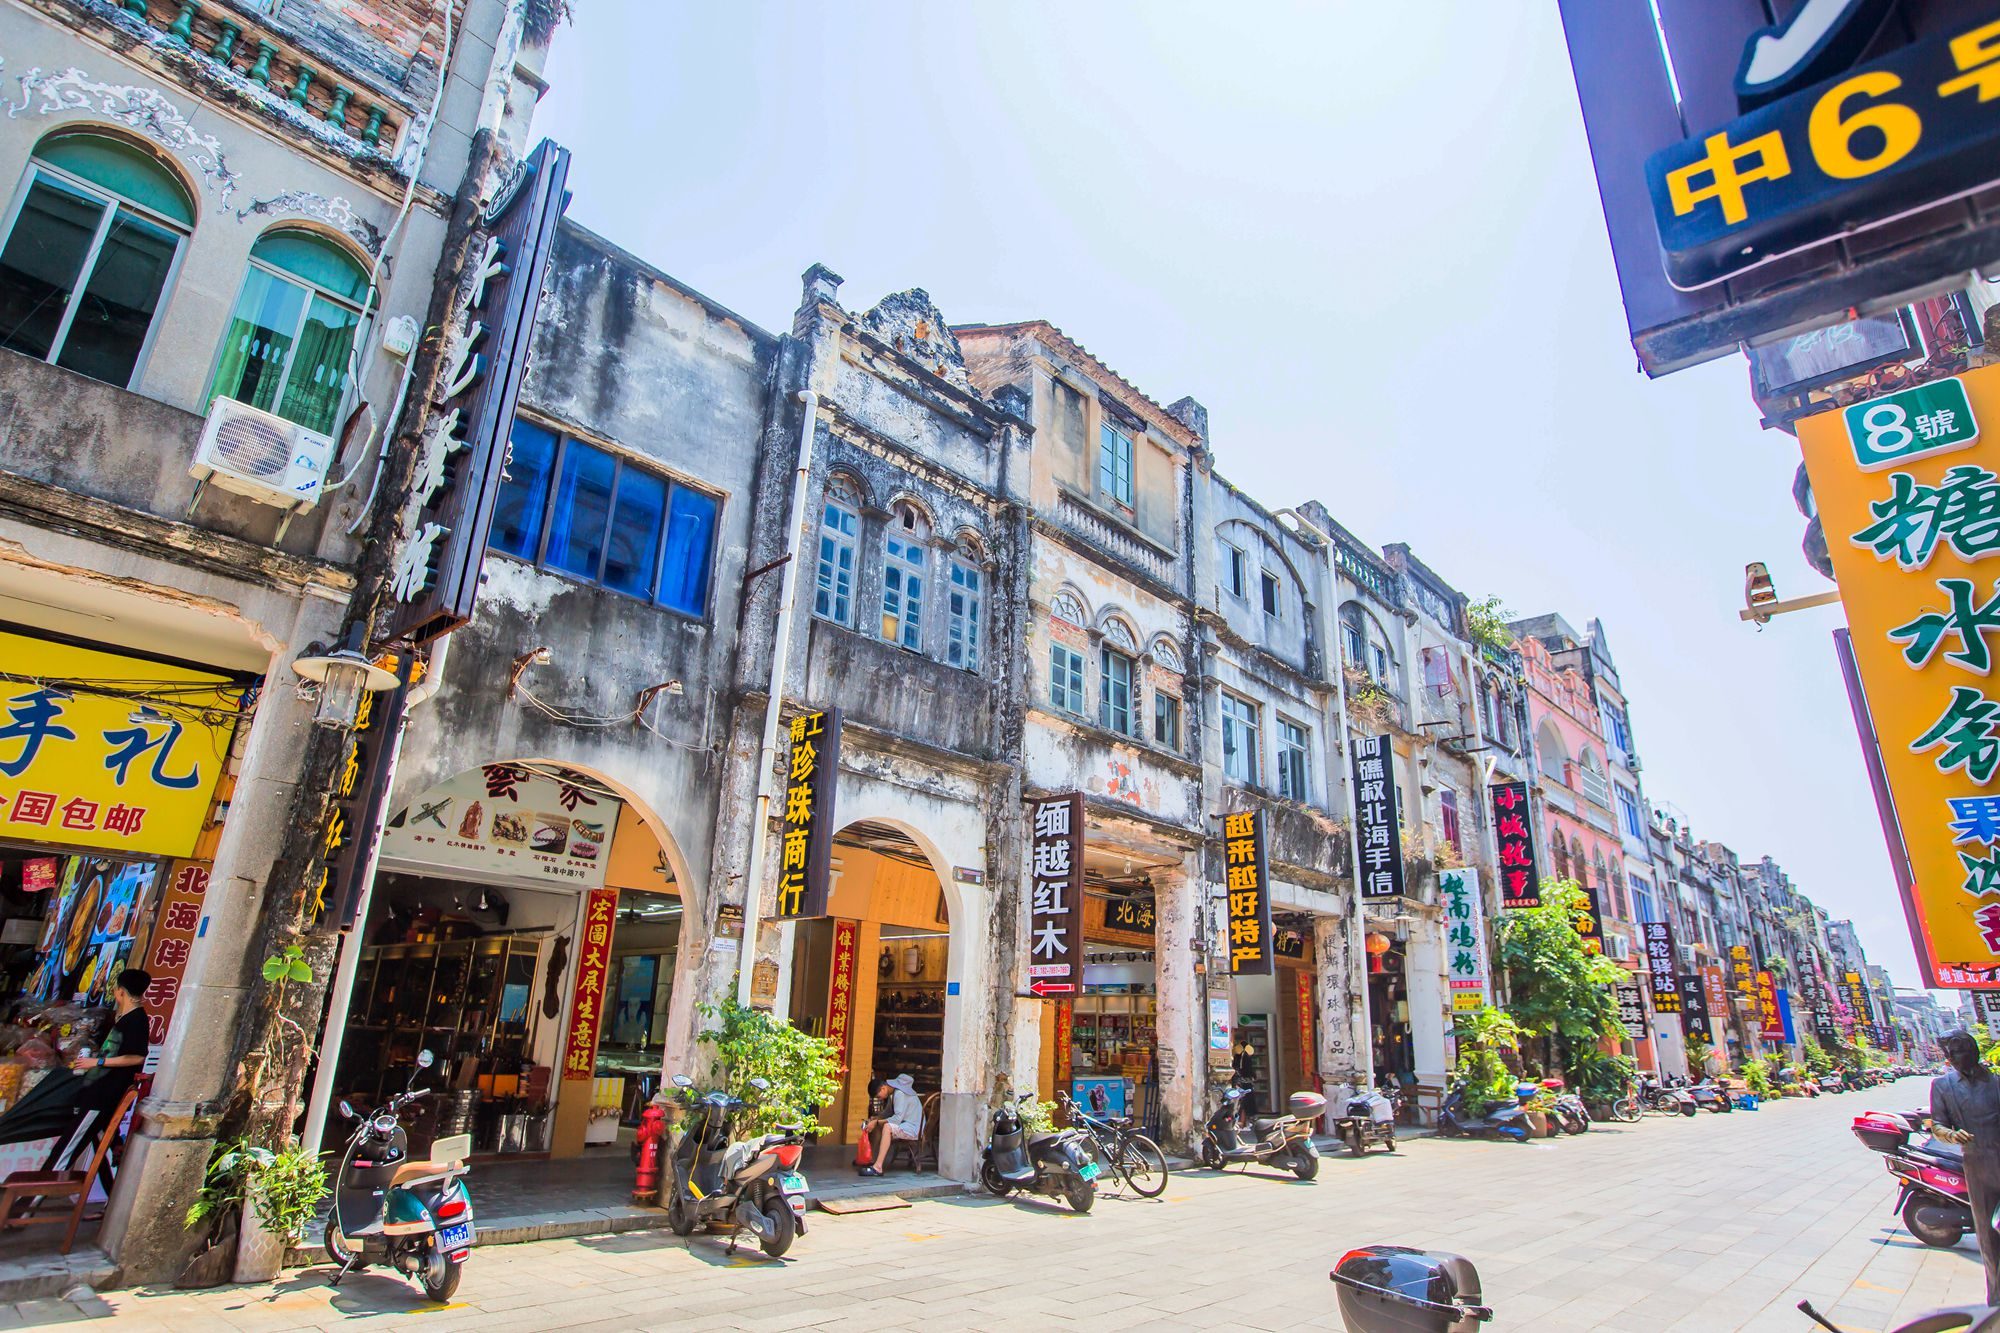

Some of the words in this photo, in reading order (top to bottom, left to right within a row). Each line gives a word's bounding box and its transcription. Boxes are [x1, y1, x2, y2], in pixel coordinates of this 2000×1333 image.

[1862, 404, 1959, 453] 8號
[790, 711, 824, 742] 精工
[0, 790, 146, 836] 国包邮
[309, 654, 399, 926] 越南红木
[777, 741, 816, 916] 珍珠商行
[1355, 737, 1395, 895] 阿礁叔北海手信
[1496, 787, 1533, 897] 小城故事
[1032, 799, 1071, 959] 缅越红木
[1116, 900, 1154, 928] 北海
[1225, 812, 1261, 971] 越来越好特产
[568, 898, 612, 1073] 宏圖大展生意旺
[1647, 924, 1675, 992] 渔轮驿站
[1938, 967, 2000, 983] 地道北海
